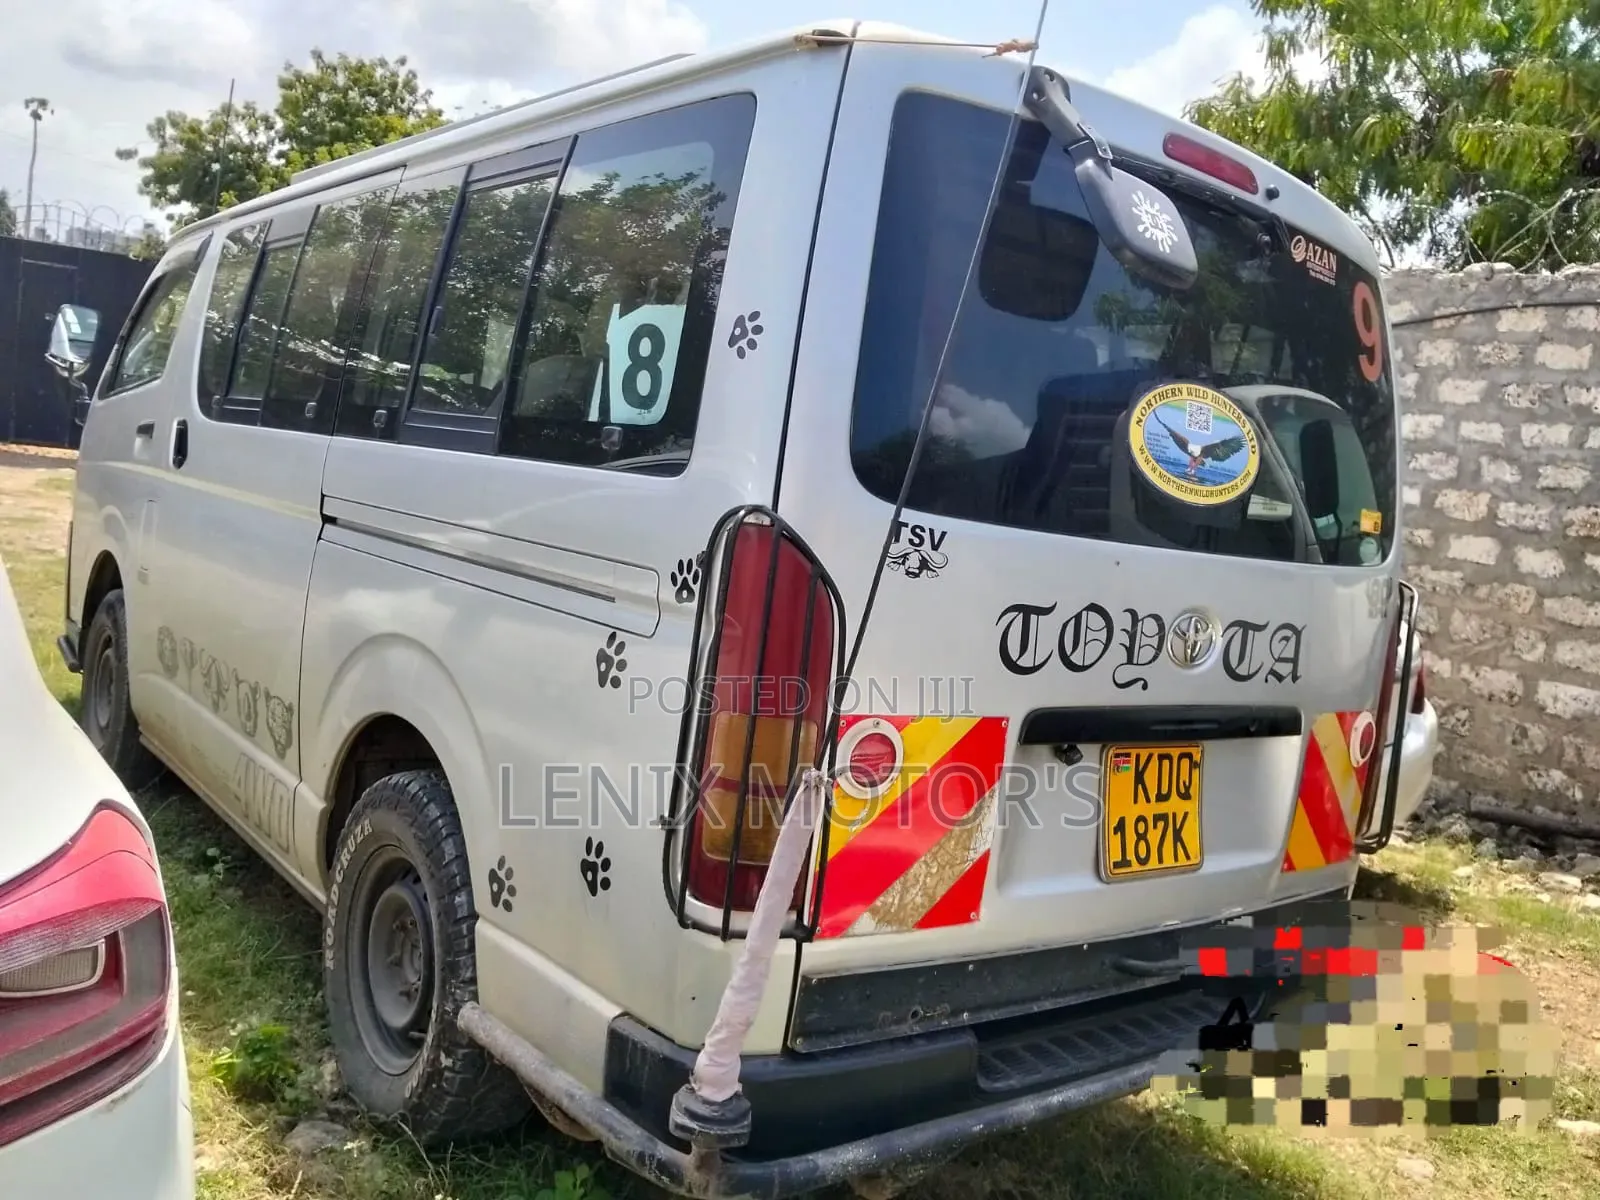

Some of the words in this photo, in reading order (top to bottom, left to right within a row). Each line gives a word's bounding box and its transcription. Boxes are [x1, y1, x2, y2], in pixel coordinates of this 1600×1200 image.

[1306, 243, 1336, 272] AZAN
[1353, 281, 1382, 382] 9
[1136, 386, 1185, 427] NORTHERN
[1186, 387, 1208, 400] WILD
[1211, 394, 1246, 428] HUNTERS
[1246, 428, 1257, 455] LTD
[891, 520, 948, 551] TSV
[1133, 752, 1194, 804] KDQ
[1112, 811, 1191, 869] 187K
[324, 818, 373, 970] ROADCRUZA
